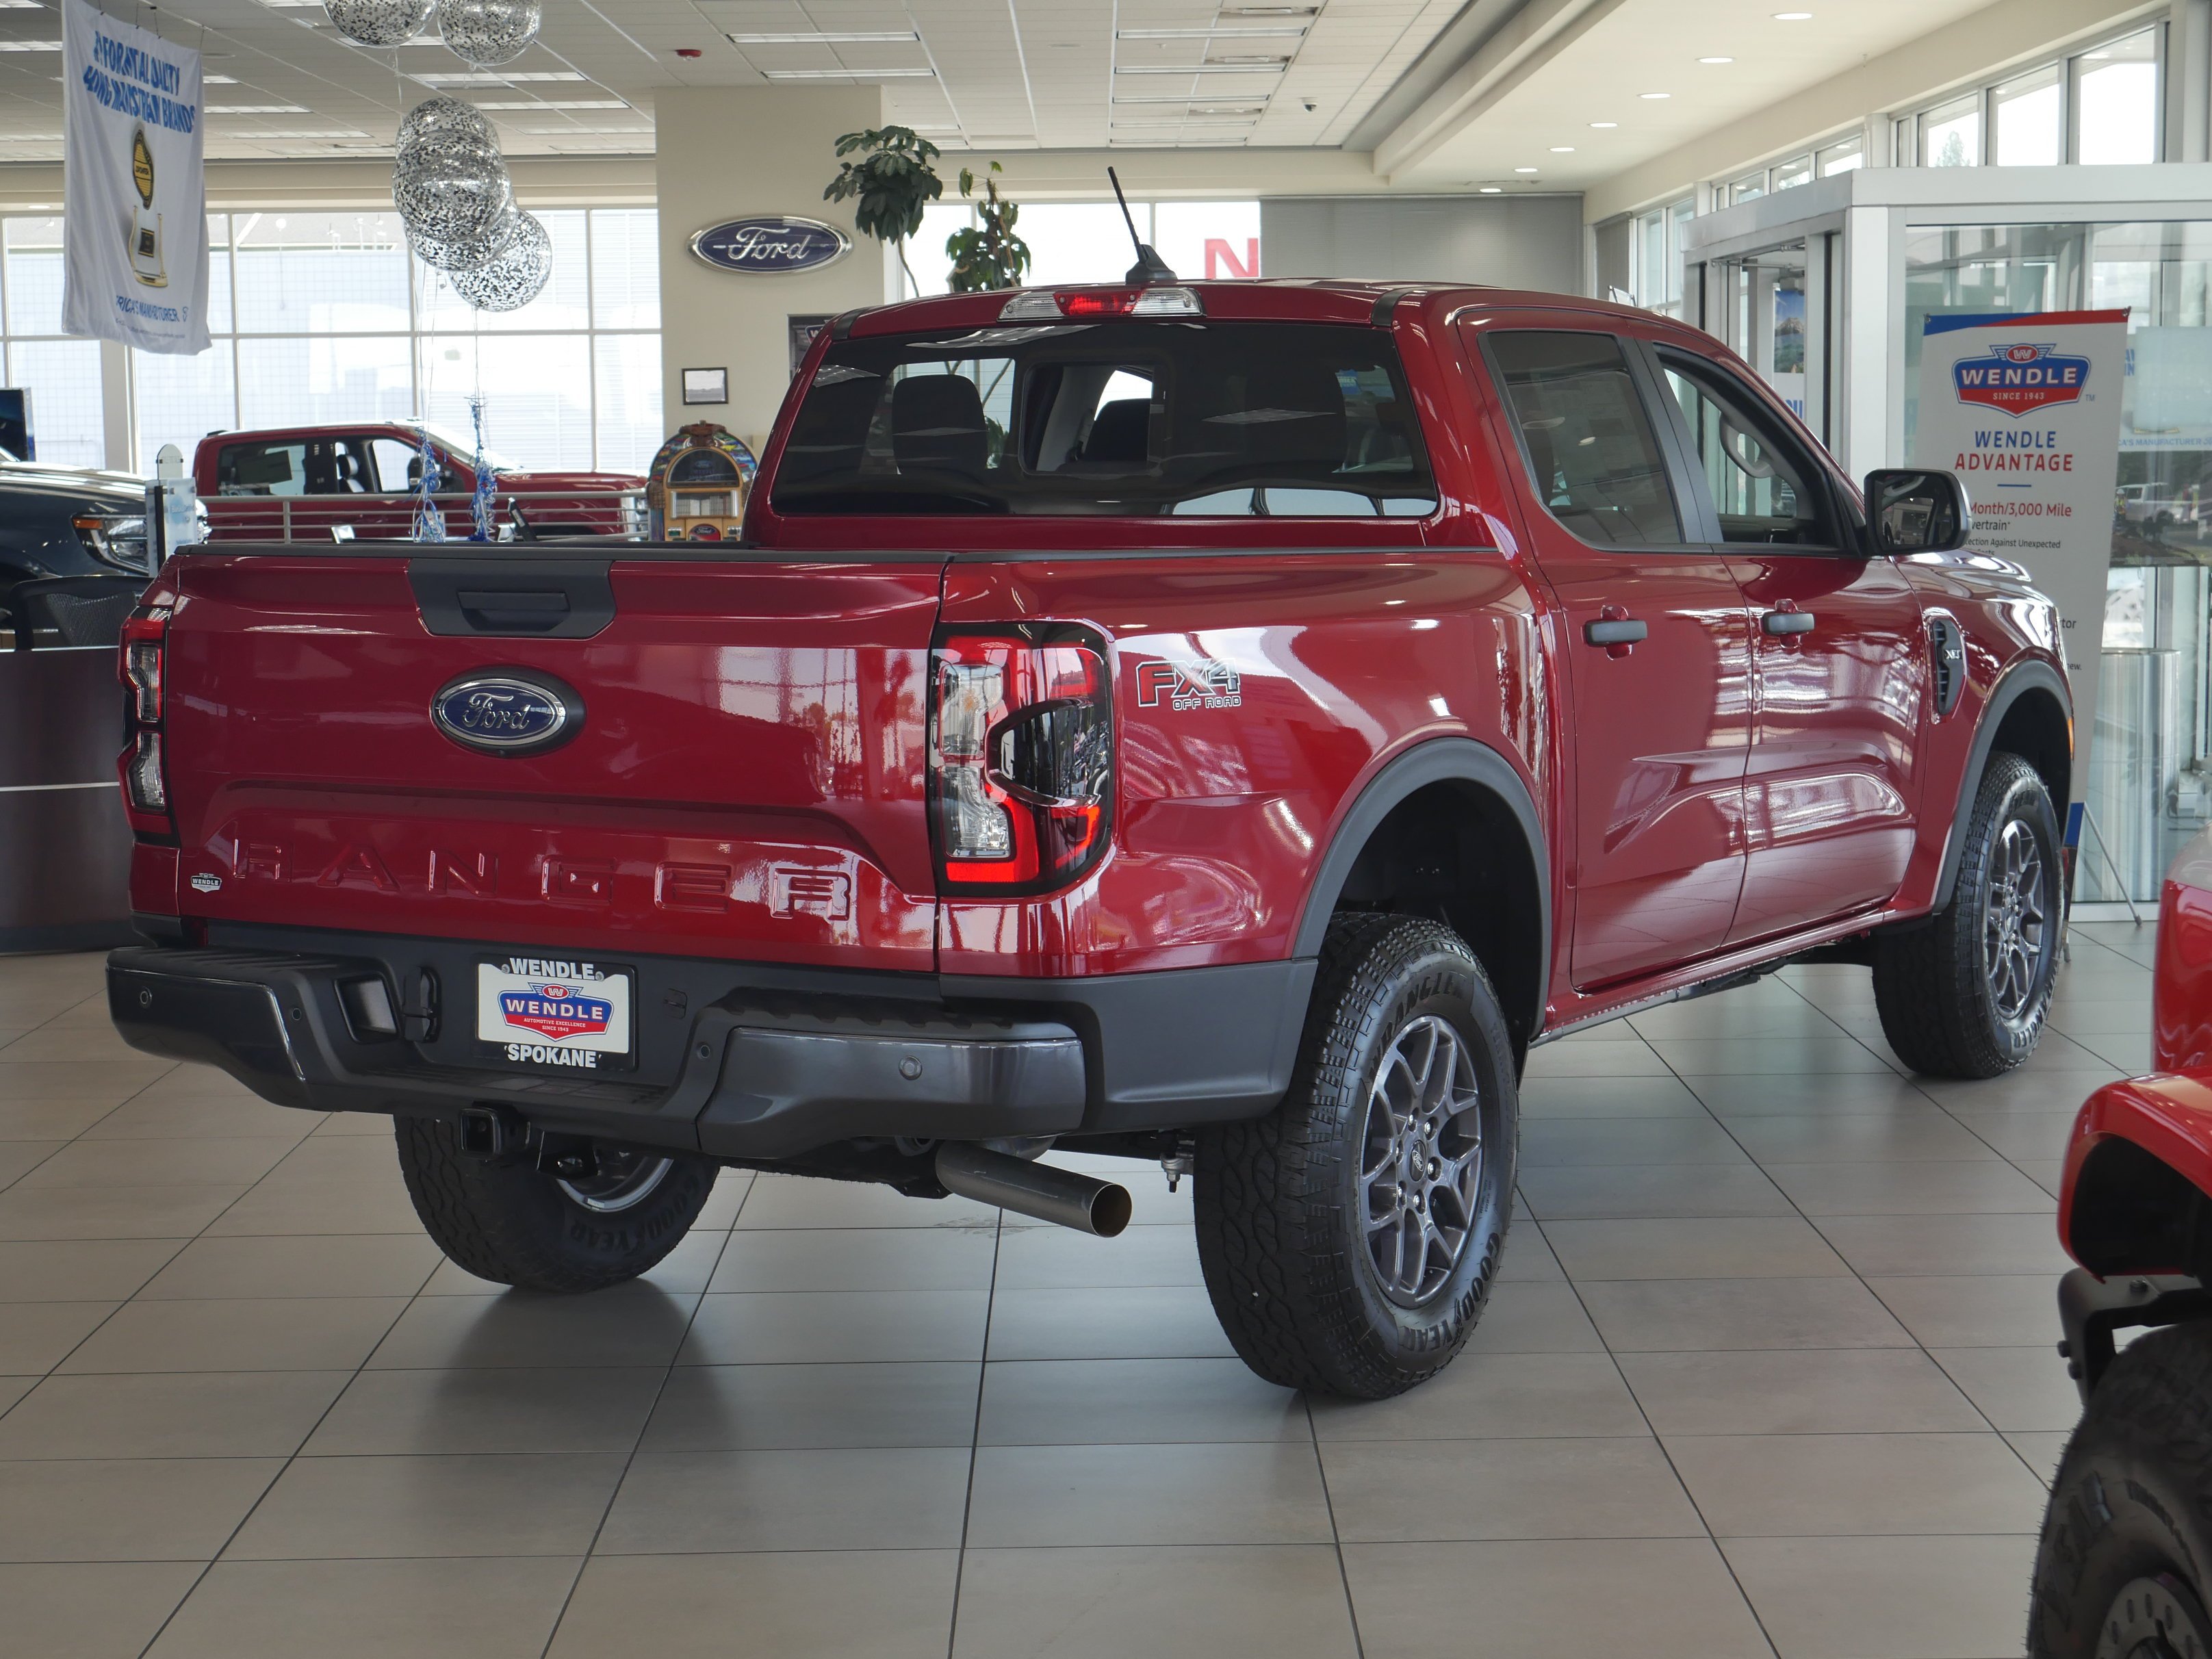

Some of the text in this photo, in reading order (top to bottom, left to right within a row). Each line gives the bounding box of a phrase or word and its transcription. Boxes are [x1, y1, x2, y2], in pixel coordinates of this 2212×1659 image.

[103, 36, 124, 74] FOR
[162, 97, 196, 133] BRANDS
[728, 227, 812, 260] Ford
[1961, 368, 2078, 385] WENDLE
[2024, 392, 2045, 400] 1943
[1975, 430, 2056, 448] WENDLE
[2135, 438, 2202, 446] MANUFACTURER
[1954, 453, 2074, 472] ADVANTAGE
[2046, 503, 2072, 517] Mile
[1990, 539, 2017, 548] Against
[2018, 539, 2061, 549] Unexpected
[2060, 618, 2077, 629] tor
[1135, 657, 1241, 708] FX4
[462, 693, 530, 730] Ford
[1172, 695, 1242, 711] OFF ROAD
[231, 836, 853, 922] RANGER
[509, 957, 595, 980] WENDLE
[506, 999, 603, 1020] WENDLE
[507, 1044, 596, 1068] SPOKANE
